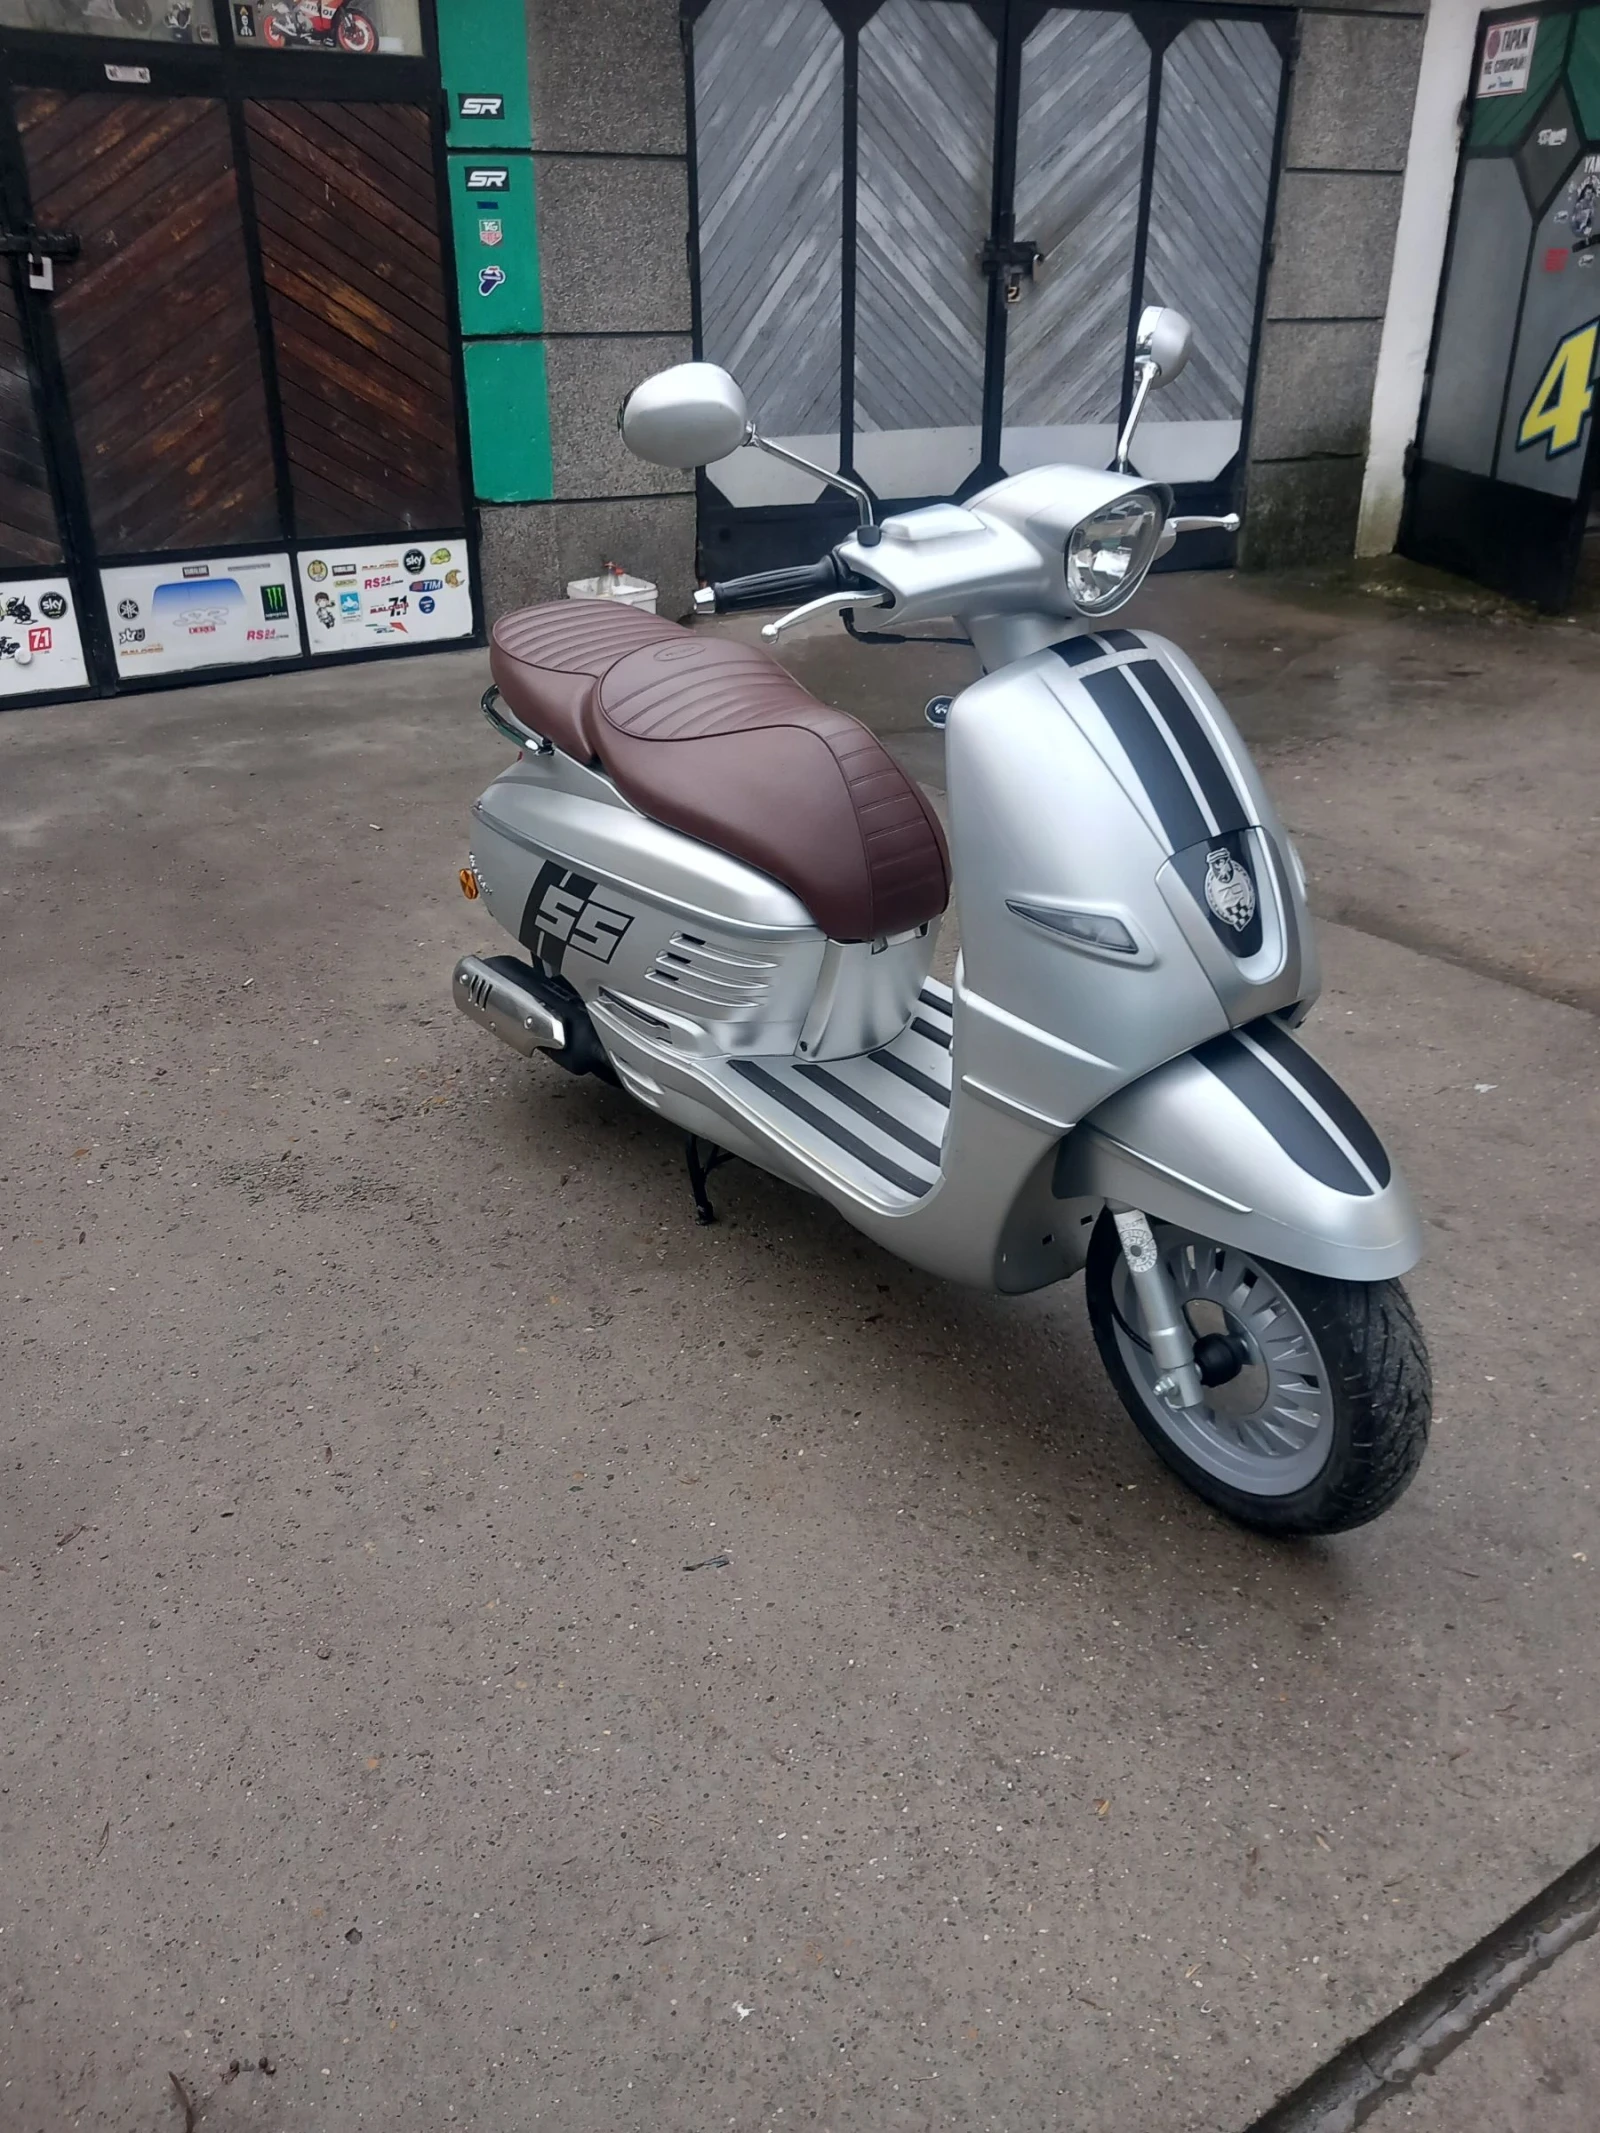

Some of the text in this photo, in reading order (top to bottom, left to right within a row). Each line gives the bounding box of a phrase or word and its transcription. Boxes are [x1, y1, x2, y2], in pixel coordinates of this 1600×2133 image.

[461, 97, 502, 115] SR
[467, 170, 507, 187] SR
[1518, 320, 1600, 458] 4
[406, 554, 423, 567] sky
[423, 580, 441, 590] TIM
[42, 598, 62, 610] sky
[31, 630, 50, 649] 7.1
[534, 884, 635, 964] SS
